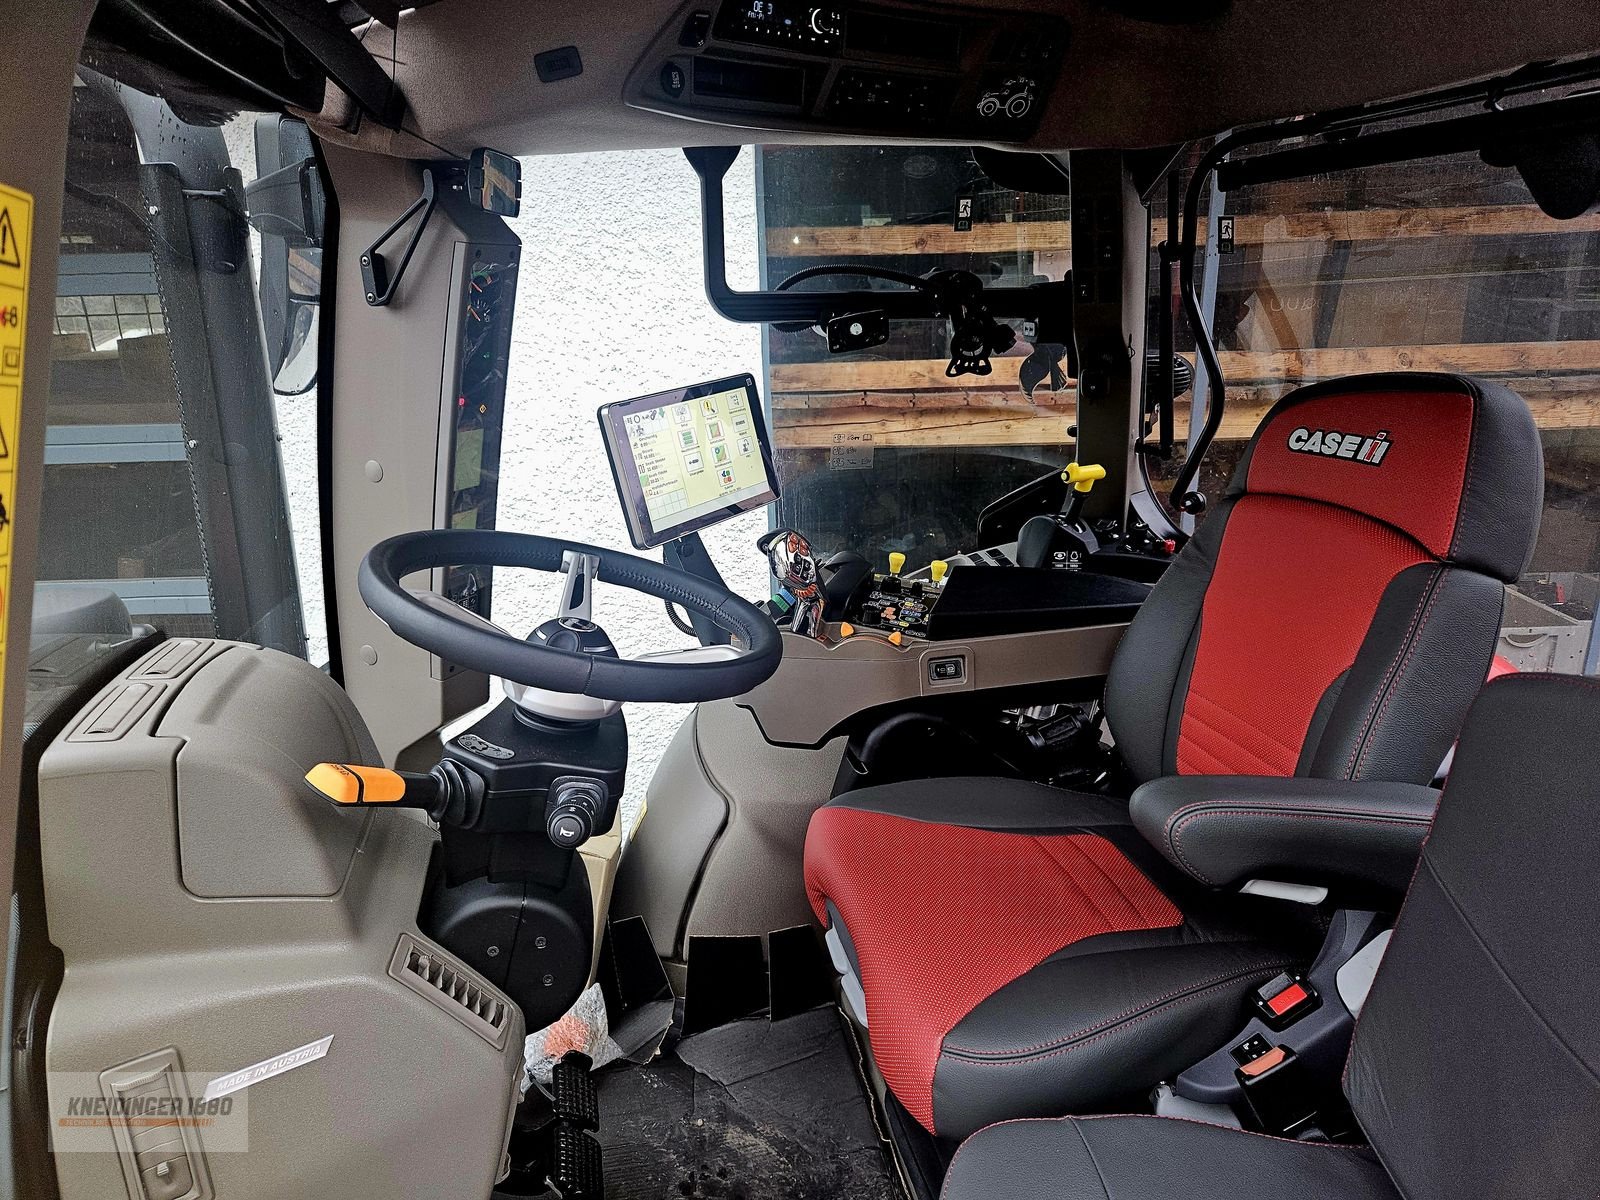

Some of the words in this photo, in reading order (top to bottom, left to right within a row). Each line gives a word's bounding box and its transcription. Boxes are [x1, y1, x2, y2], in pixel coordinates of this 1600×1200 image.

[767, 3, 773, 15] 3
[1288, 428, 1362, 458] CASE
[216, 1071, 252, 1092] MADE
[253, 1065, 271, 1079] IN
[271, 1045, 321, 1071] AUSTRIA
